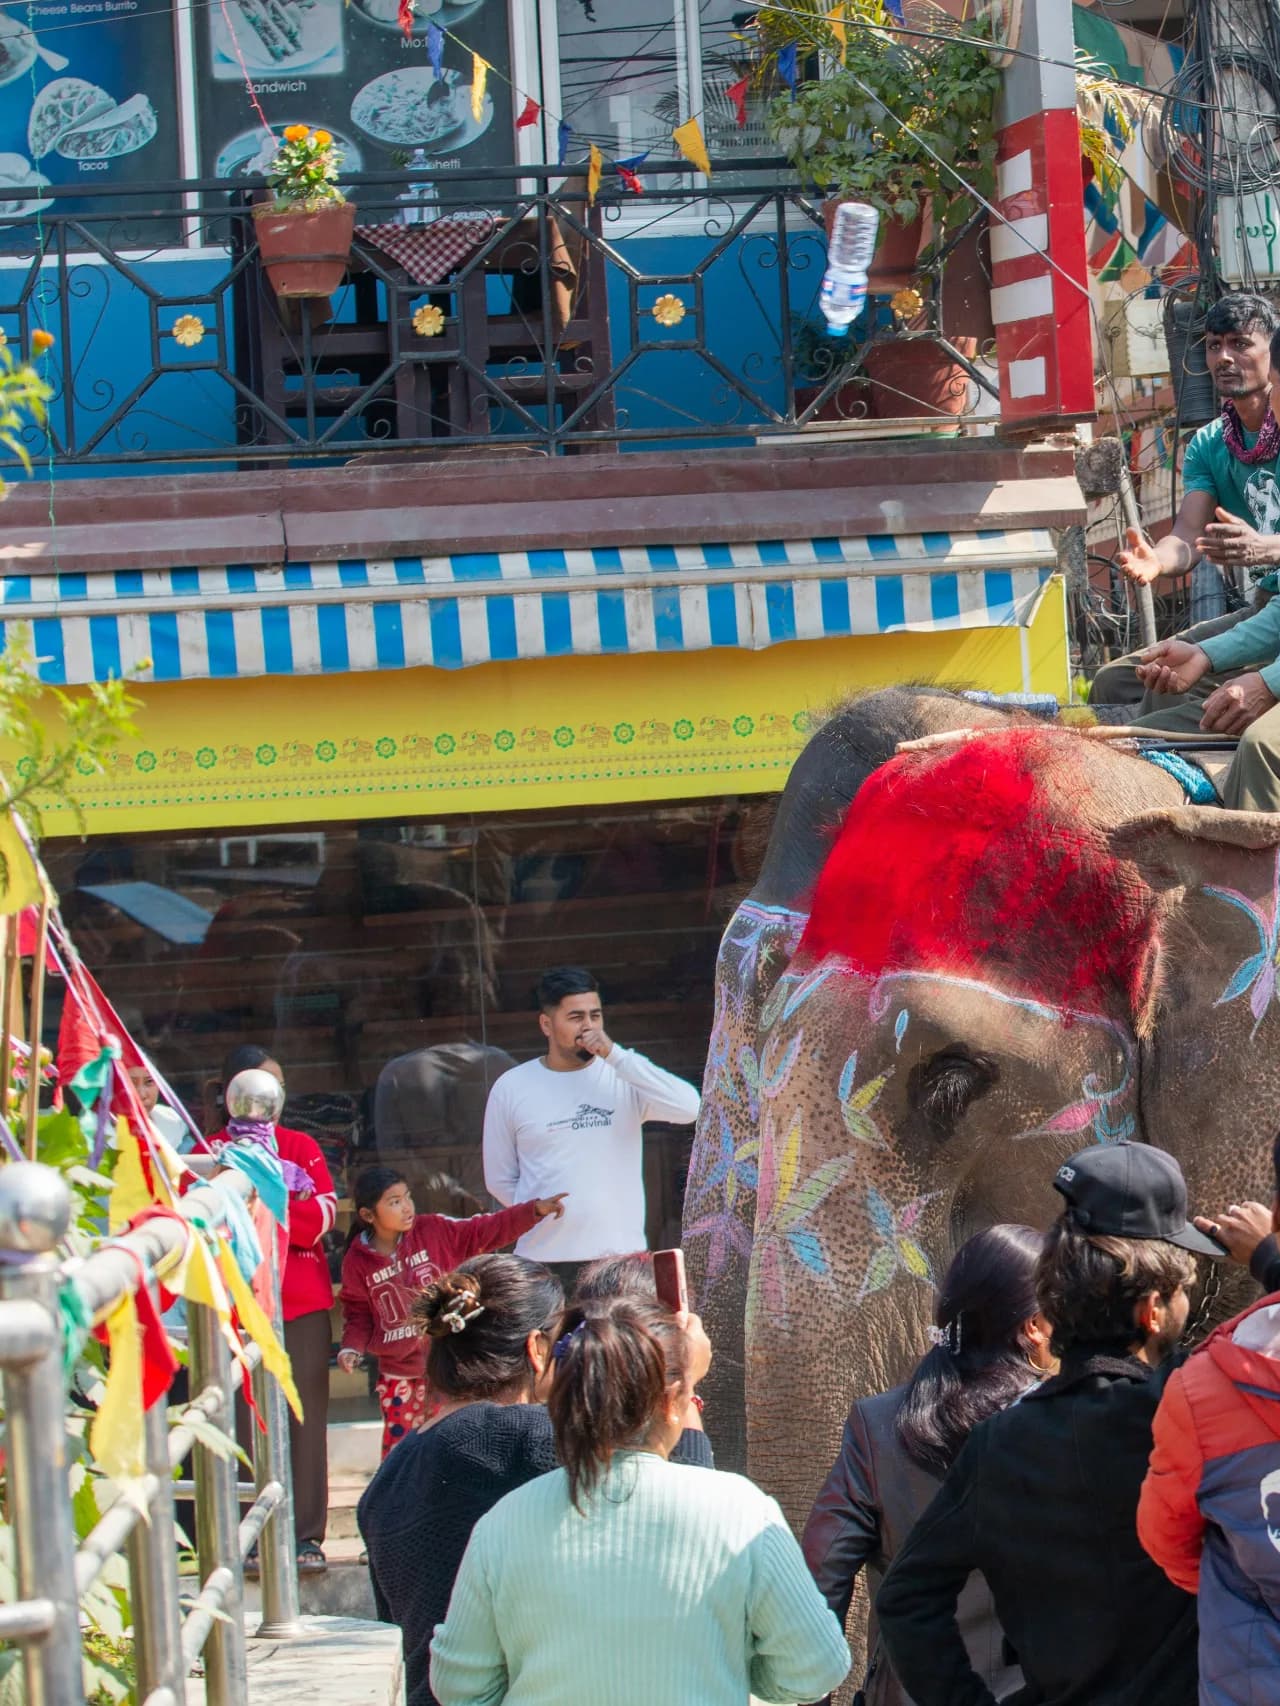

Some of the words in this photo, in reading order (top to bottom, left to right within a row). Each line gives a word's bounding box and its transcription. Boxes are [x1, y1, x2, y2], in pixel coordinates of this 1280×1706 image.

[27, 6, 67, 16] Cheese
[70, 3, 102, 13] Beans
[105, 1, 137, 11] Burrito
[245, 80, 307, 94] Sandwich
[78, 161, 108, 172] Tacos
